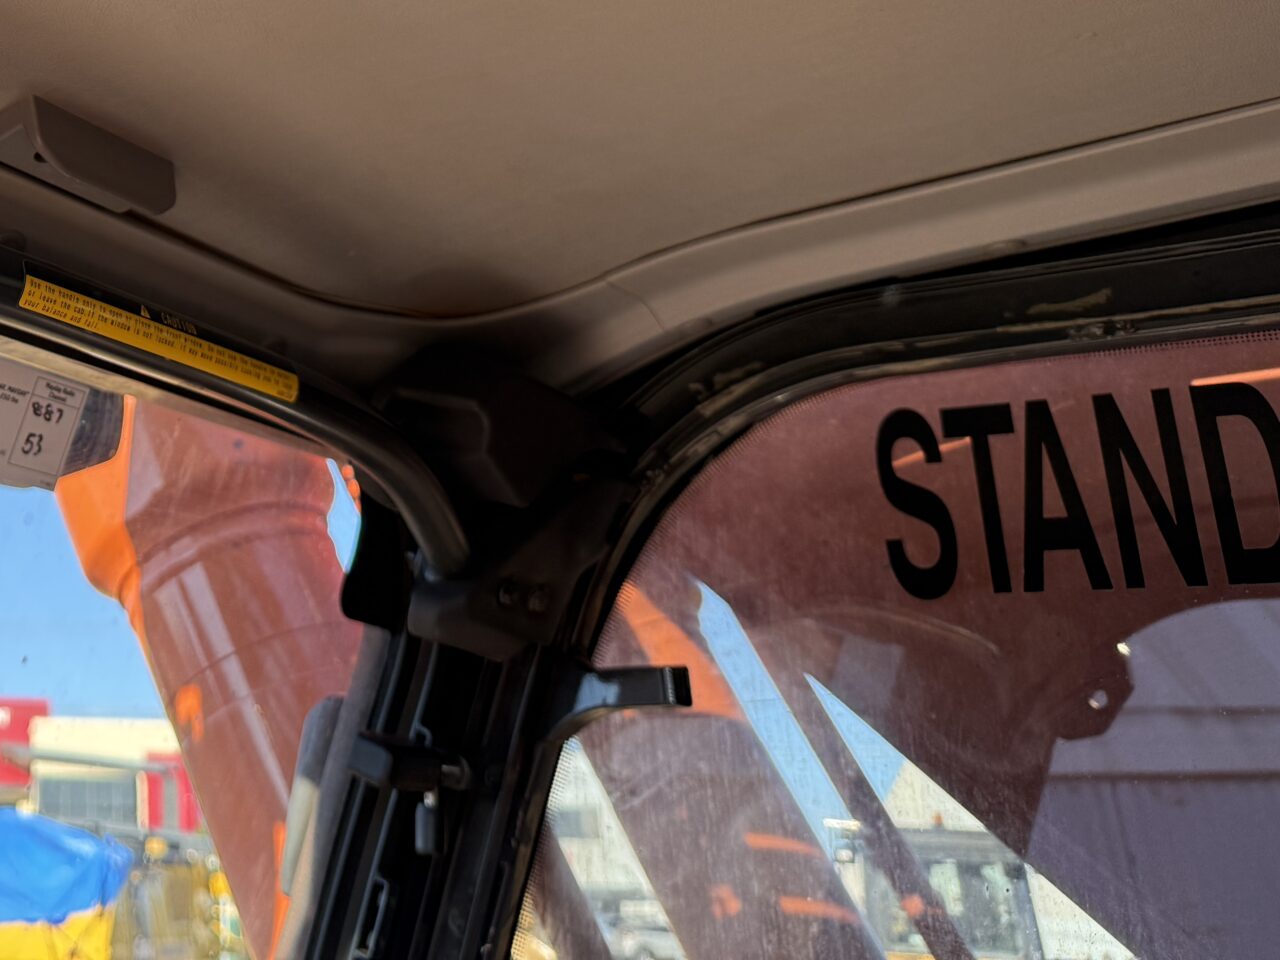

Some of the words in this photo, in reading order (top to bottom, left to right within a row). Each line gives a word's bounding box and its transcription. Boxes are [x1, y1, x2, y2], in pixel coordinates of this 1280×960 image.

[24, 299, 39, 308] your
[41, 303, 67, 318] balance
[69, 315, 81, 323] and
[39, 293, 56, 304] leave
[60, 300, 70, 309] the
[97, 314, 107, 323] the
[110, 319, 130, 331] window
[142, 330, 152, 338] not
[45, 284, 55, 294] the
[58, 289, 79, 303] handle
[82, 299, 96, 309] only
[108, 308, 123, 318] open
[21, 433, 43, 455] 53
[876, 381, 1280, 600] STAND
